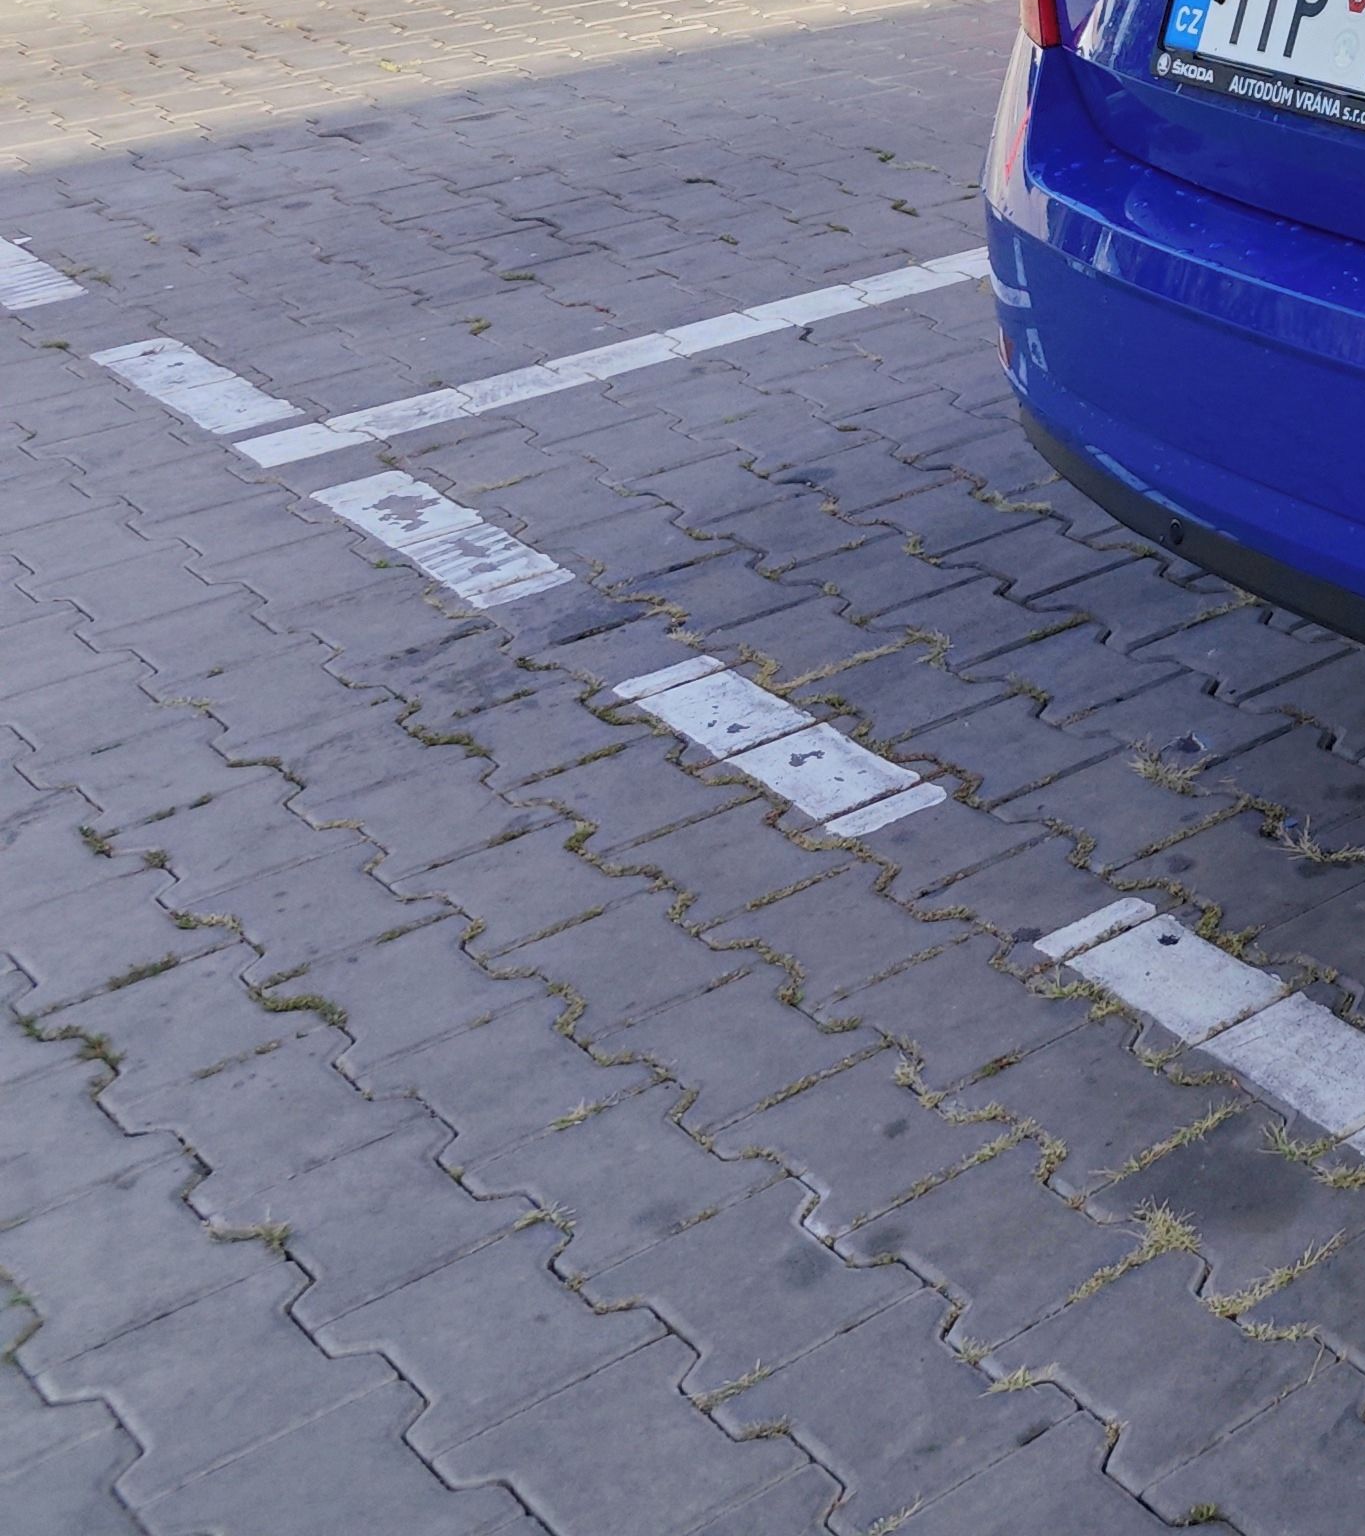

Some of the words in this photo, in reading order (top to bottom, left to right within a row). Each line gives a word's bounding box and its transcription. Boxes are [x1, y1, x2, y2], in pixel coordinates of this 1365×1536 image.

[1176, 5, 1203, 35] CZ
[1172, 59, 1214, 83] ŠKODA
[1228, 75, 1294, 106] AUTODŮM
[1295, 91, 1341, 119] VRÁNA
